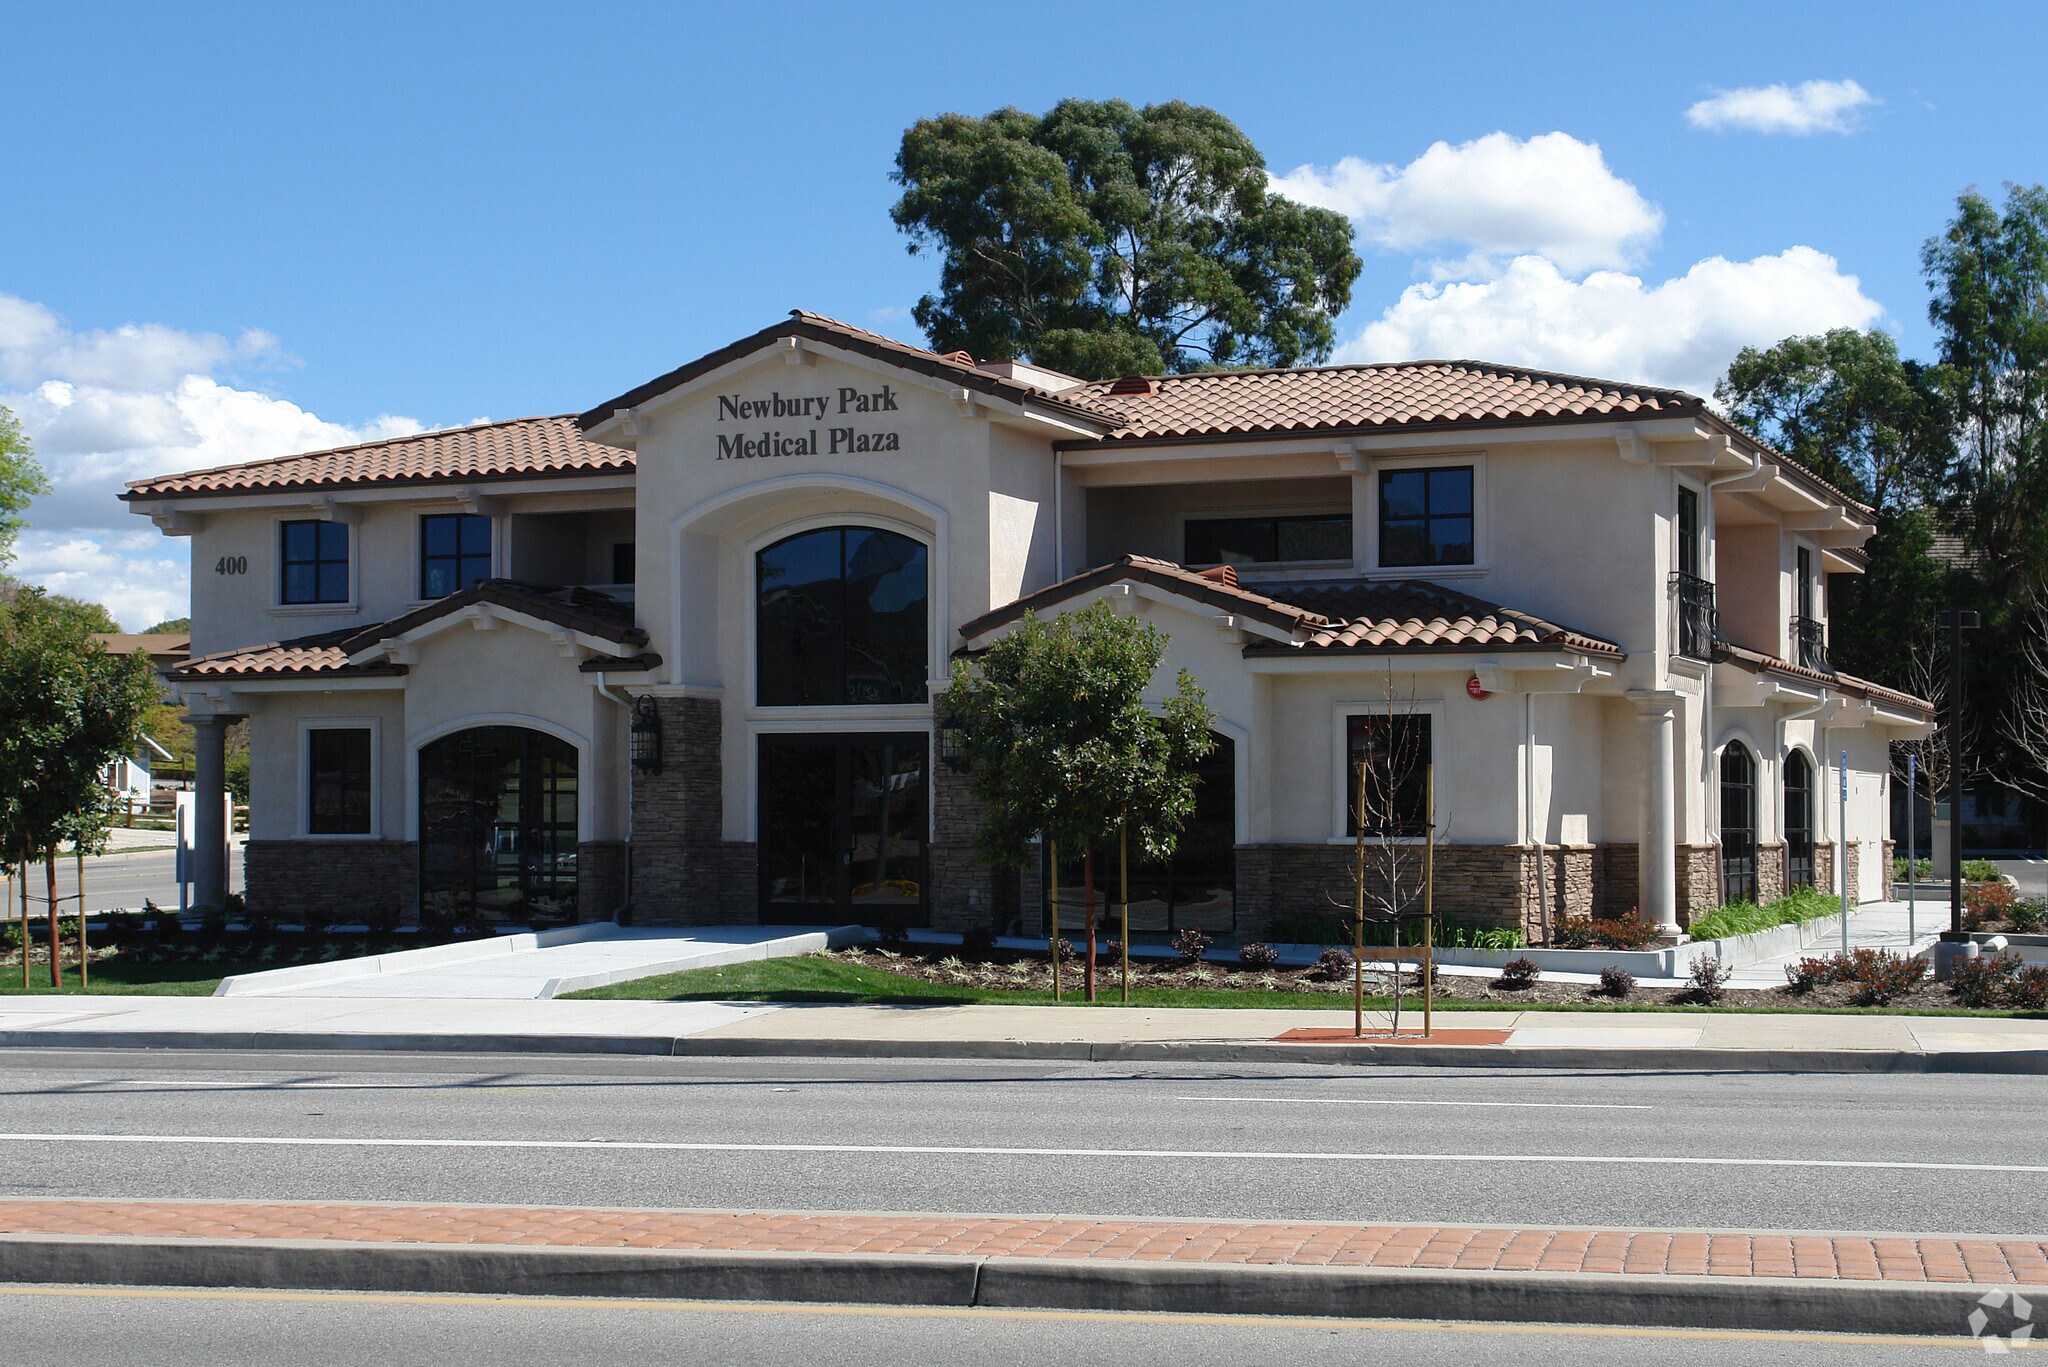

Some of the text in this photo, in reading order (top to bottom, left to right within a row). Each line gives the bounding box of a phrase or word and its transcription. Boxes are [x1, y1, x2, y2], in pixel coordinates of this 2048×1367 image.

[717, 385, 898, 420] Newbury Park
[716, 427, 900, 460] Medical Plaza
[215, 556, 247, 575] 400
